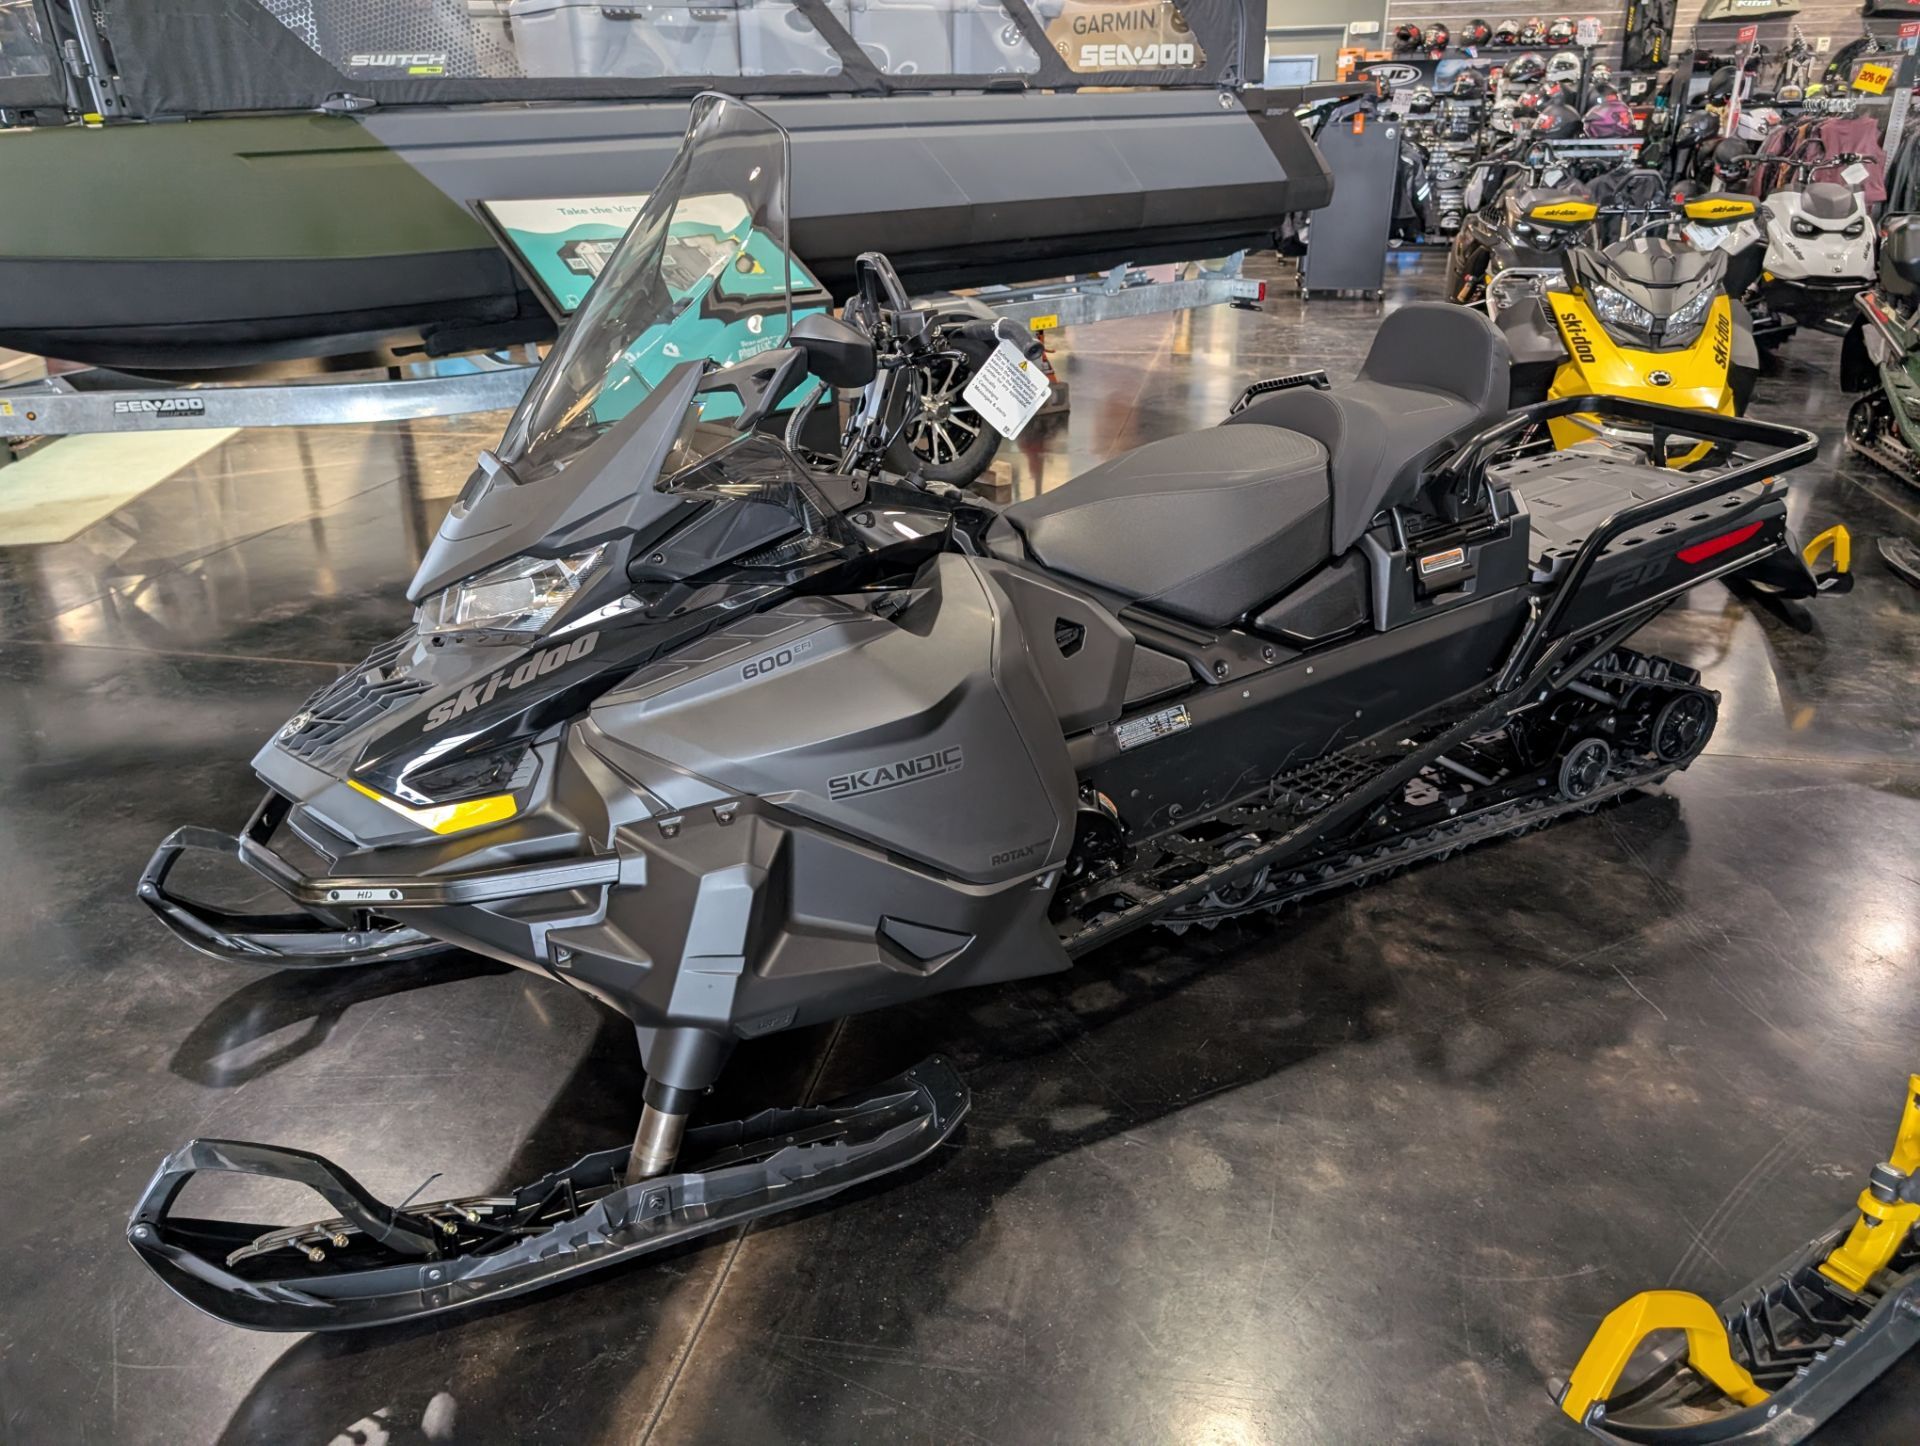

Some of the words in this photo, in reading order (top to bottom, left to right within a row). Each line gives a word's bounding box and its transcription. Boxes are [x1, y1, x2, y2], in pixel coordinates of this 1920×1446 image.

[1073, 9, 1155, 34] GARMIN
[350, 54, 446, 66] SWITCH
[590, 206, 612, 214] the
[613, 205, 641, 213] Virt
[1561, 313, 1595, 364] ski-doo
[1714, 313, 1730, 369] ski-doo
[743, 650, 792, 679] 600
[794, 641, 811, 653] EFI
[829, 746, 962, 794] SKANDIC
[992, 845, 1034, 866] ROTAX
